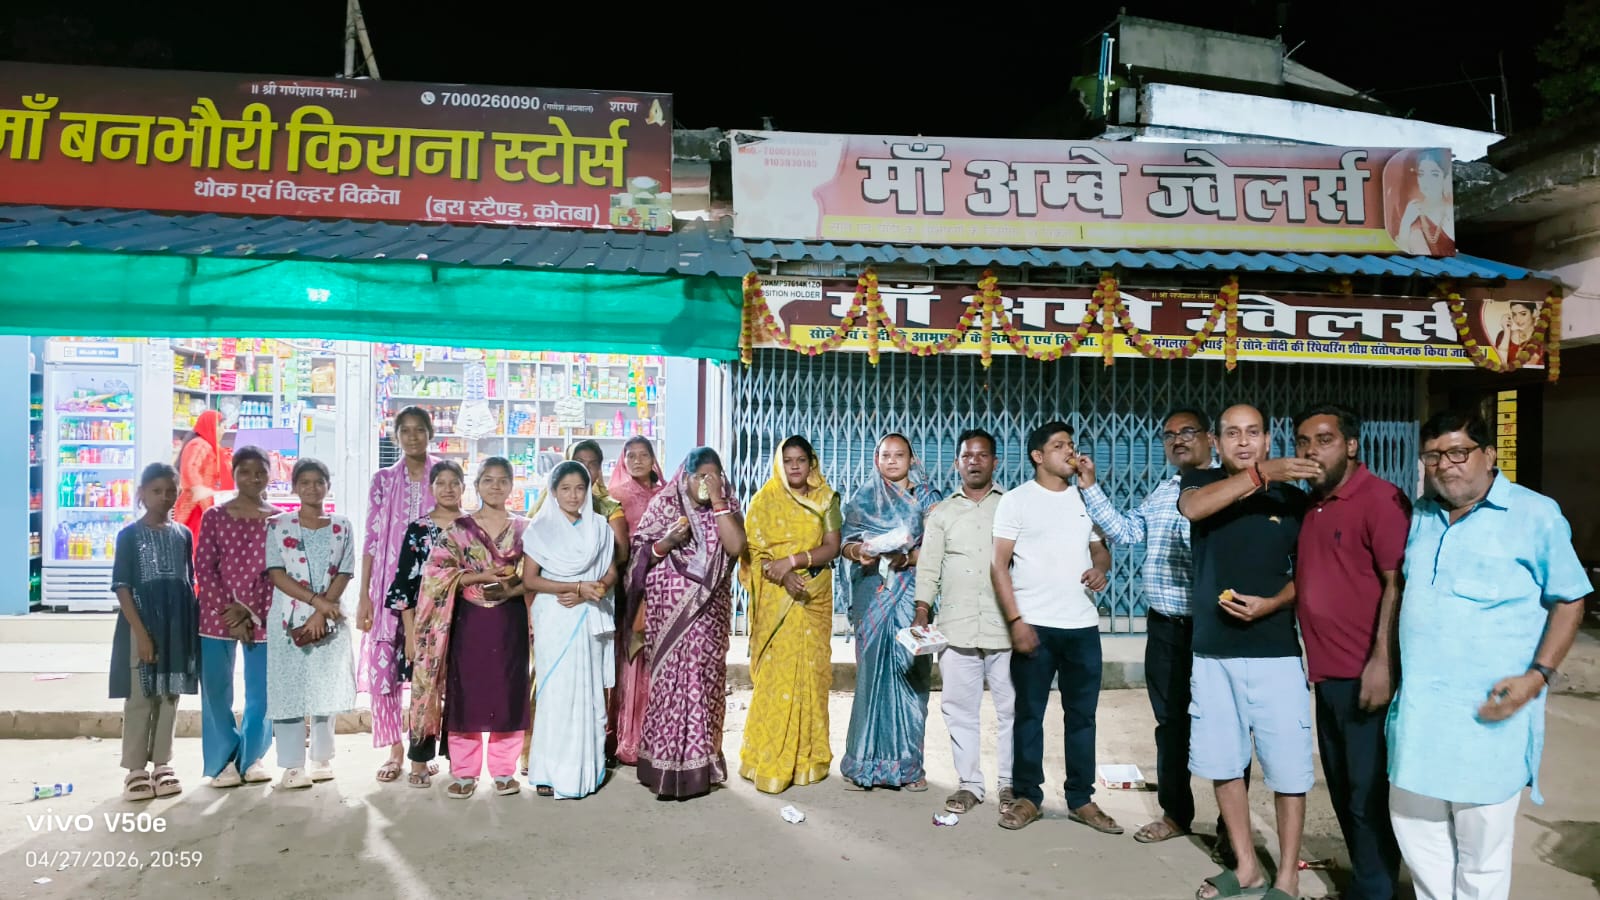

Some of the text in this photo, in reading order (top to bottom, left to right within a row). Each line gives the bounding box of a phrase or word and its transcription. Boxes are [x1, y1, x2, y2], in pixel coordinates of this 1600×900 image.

[263, 81, 277, 95] श्री
[278, 82, 324, 97] गणेशाय
[441, 92, 540, 110] 7000260090
[609, 101, 639, 112] शरण
[59, 97, 279, 171] बनभौरी
[285, 105, 485, 180] किराना
[491, 116, 630, 188] स्टोर्स
[194, 177, 401, 205] थोक एवं चिल्हर विक्रेता
[857, 143, 1372, 224] माँ अम्बे ज्वेलर्स
[425, 195, 464, 218] (बस
[532, 200, 600, 225] कोतबा)
[790, 291, 820, 299] HOLDER
[1033, 333, 1053, 344] एवं
[1291, 340, 1304, 352] की
[1424, 345, 1448, 357] किया
